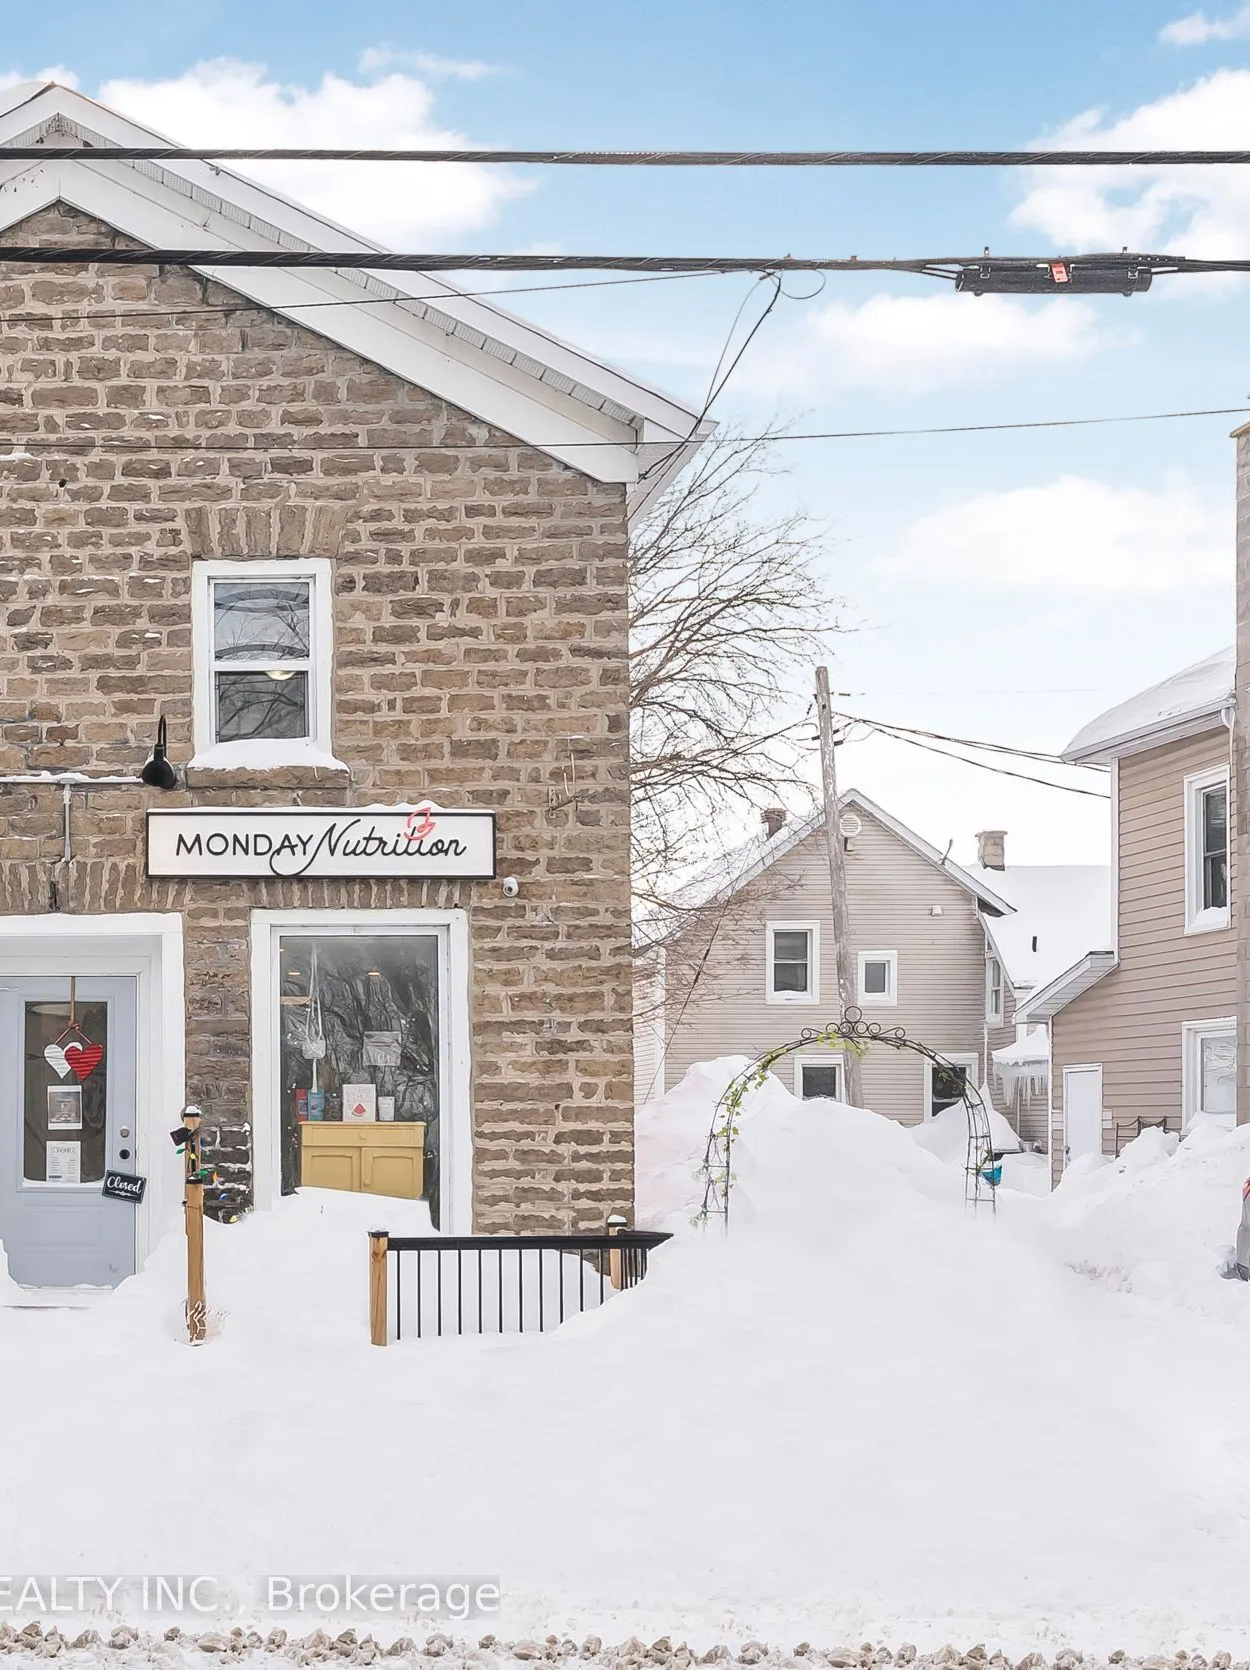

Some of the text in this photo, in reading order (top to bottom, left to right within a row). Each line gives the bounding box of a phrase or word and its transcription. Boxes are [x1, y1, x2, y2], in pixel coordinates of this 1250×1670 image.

[176, 818, 467, 877] MONDAY Nutrition
[107, 1175, 142, 1194] Closed
